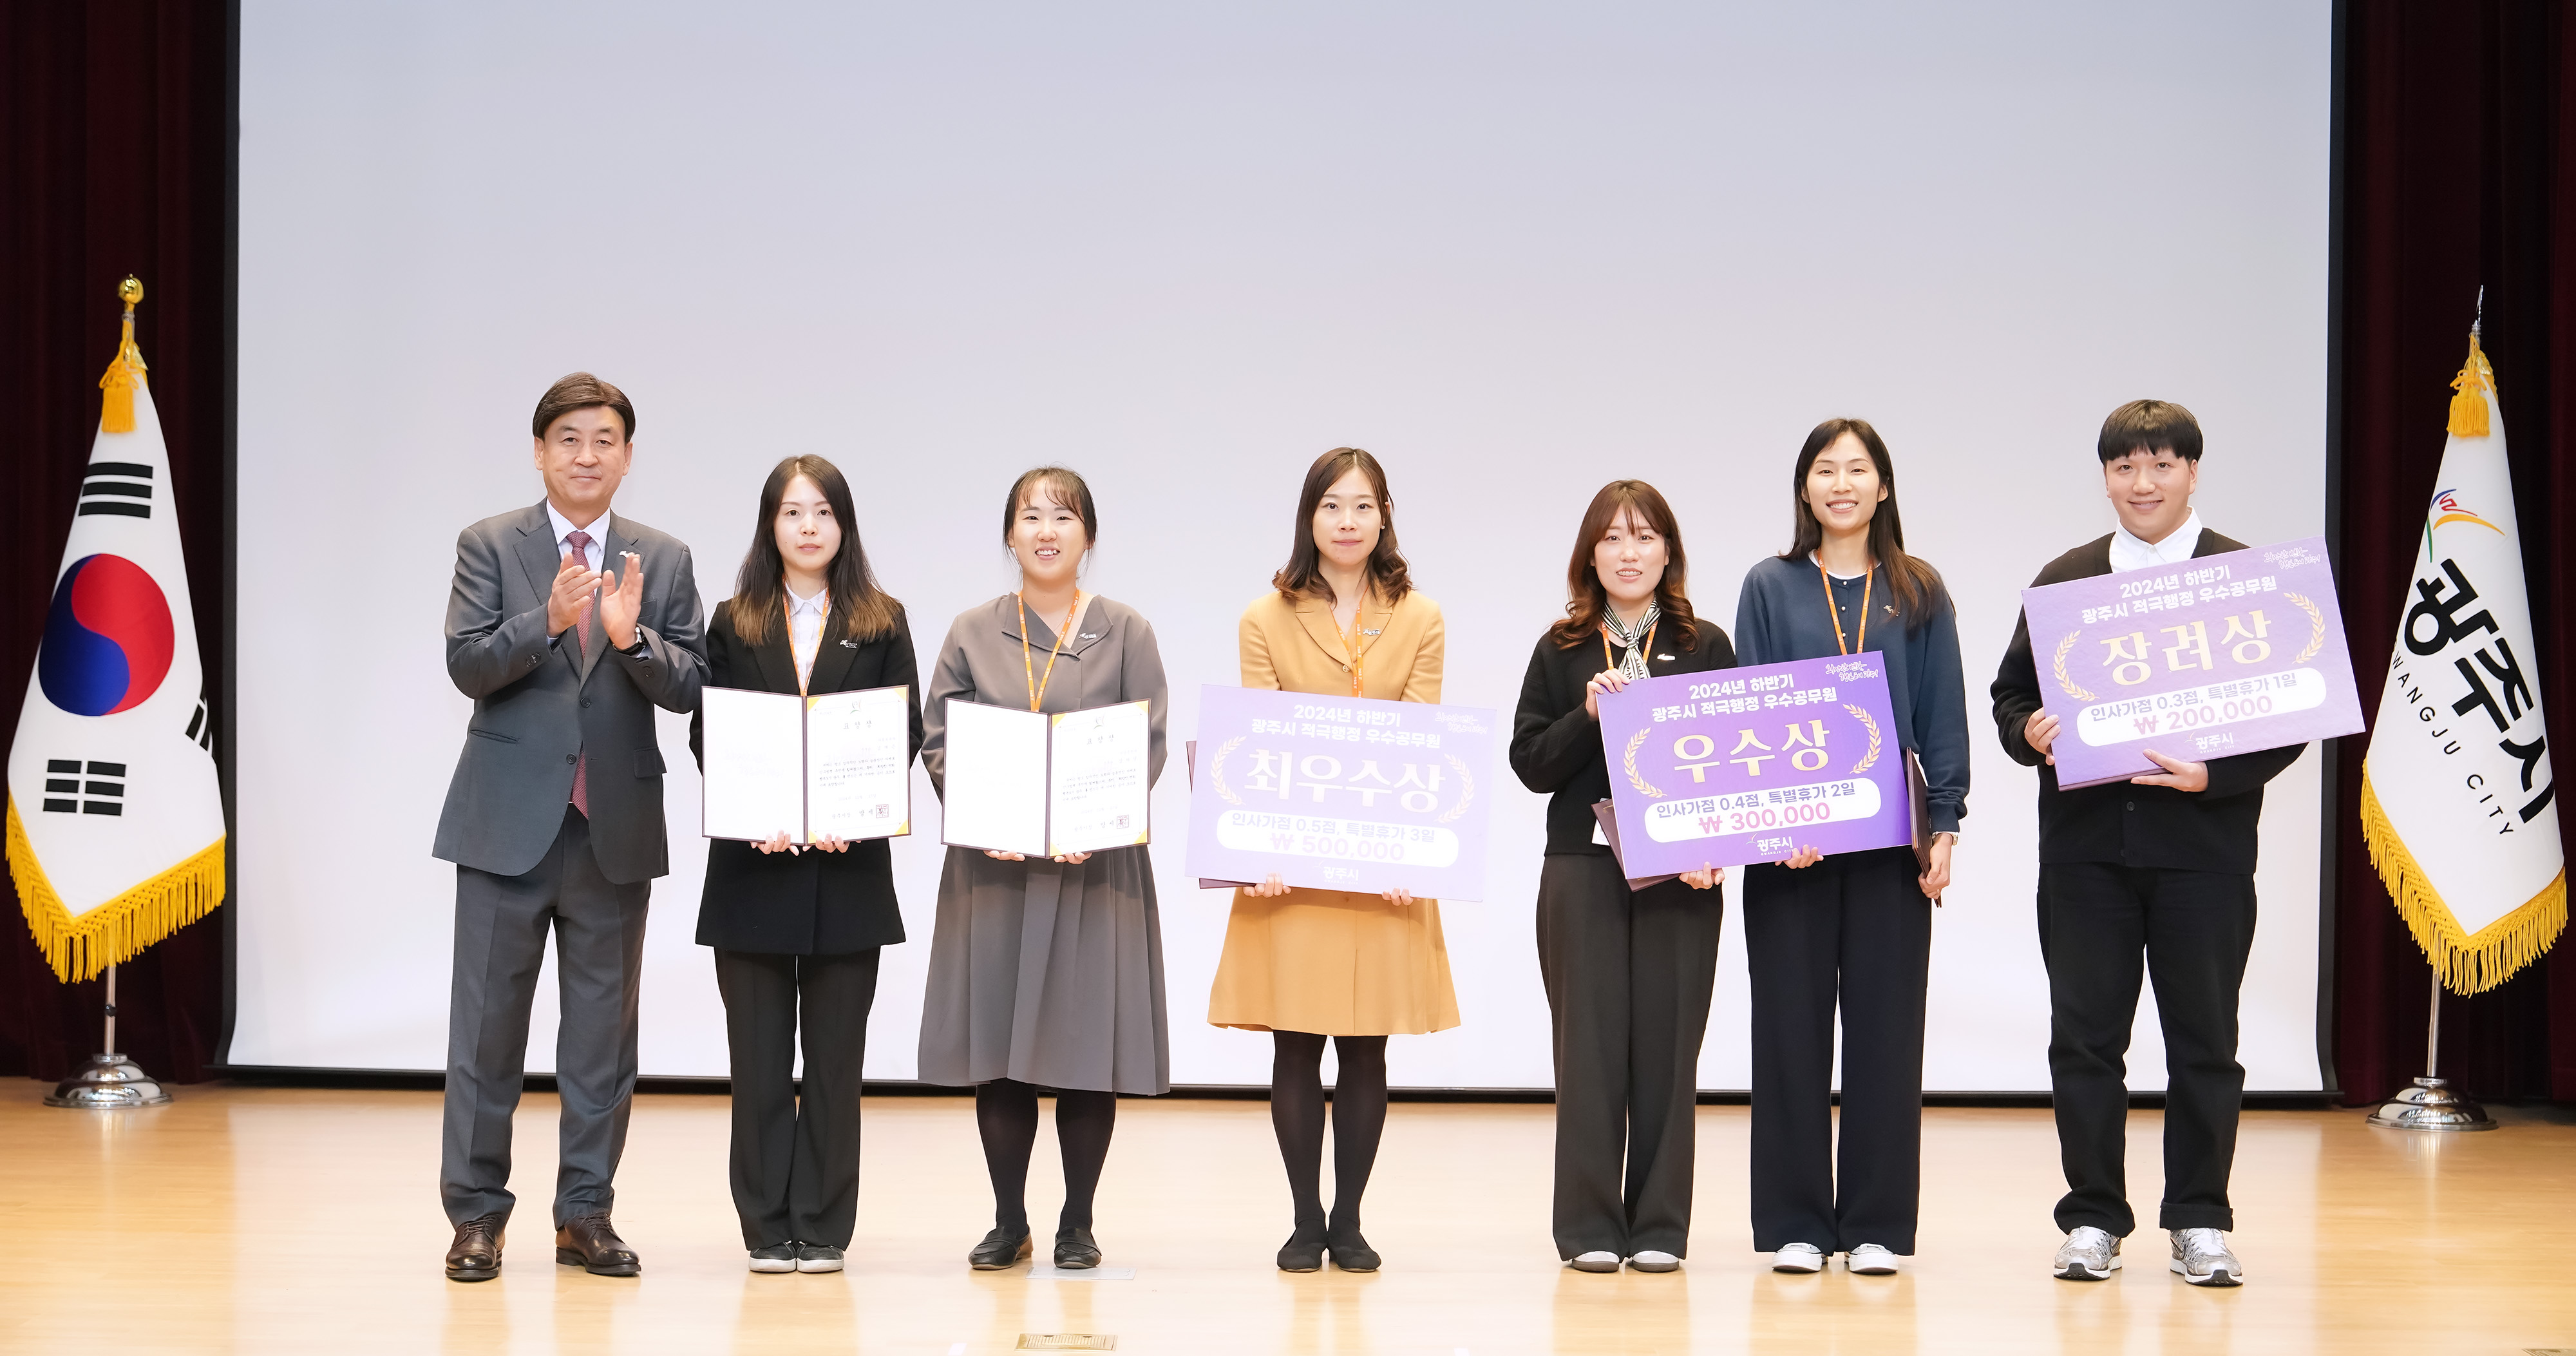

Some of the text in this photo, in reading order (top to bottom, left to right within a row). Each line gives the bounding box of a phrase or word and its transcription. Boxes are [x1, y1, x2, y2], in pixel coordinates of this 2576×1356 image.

[2119, 565, 2231, 598] 2024년 하반기
[2081, 575, 2277, 624] 광주시 적극행정 우수공무원
[2100, 609, 2271, 686] 장려상
[1689, 673, 1794, 700] 2024년 하반기
[2090, 673, 2297, 721] 인사가점 0.3점, 특별휴가 1일
[2404, 559, 2555, 823] 광주시
[1294, 705, 1401, 727] 2024년 하반기
[1652, 687, 1837, 722] 광주시 적극행정 우수공무원
[2166, 696, 2272, 731] 200,000
[1251, 718, 1441, 749] 광주시 적극행정 우수공무원
[2195, 732, 2233, 750] 광주시
[2392, 641, 2514, 836] WANGJU CITY
[1673, 720, 1830, 783] 우수상
[1244, 748, 1446, 814] 최우수상
[1656, 781, 1855, 819] 인사가점 0.4점, 특별휴가 2일
[1730, 802, 1830, 831] 300,000
[1232, 812, 1435, 843] 인사가점 0.5점, 특별휴가 3일
[1757, 836, 1793, 852] 광주시
[1302, 836, 1405, 861] 500,000
[1323, 866, 1359, 881] 광주시
